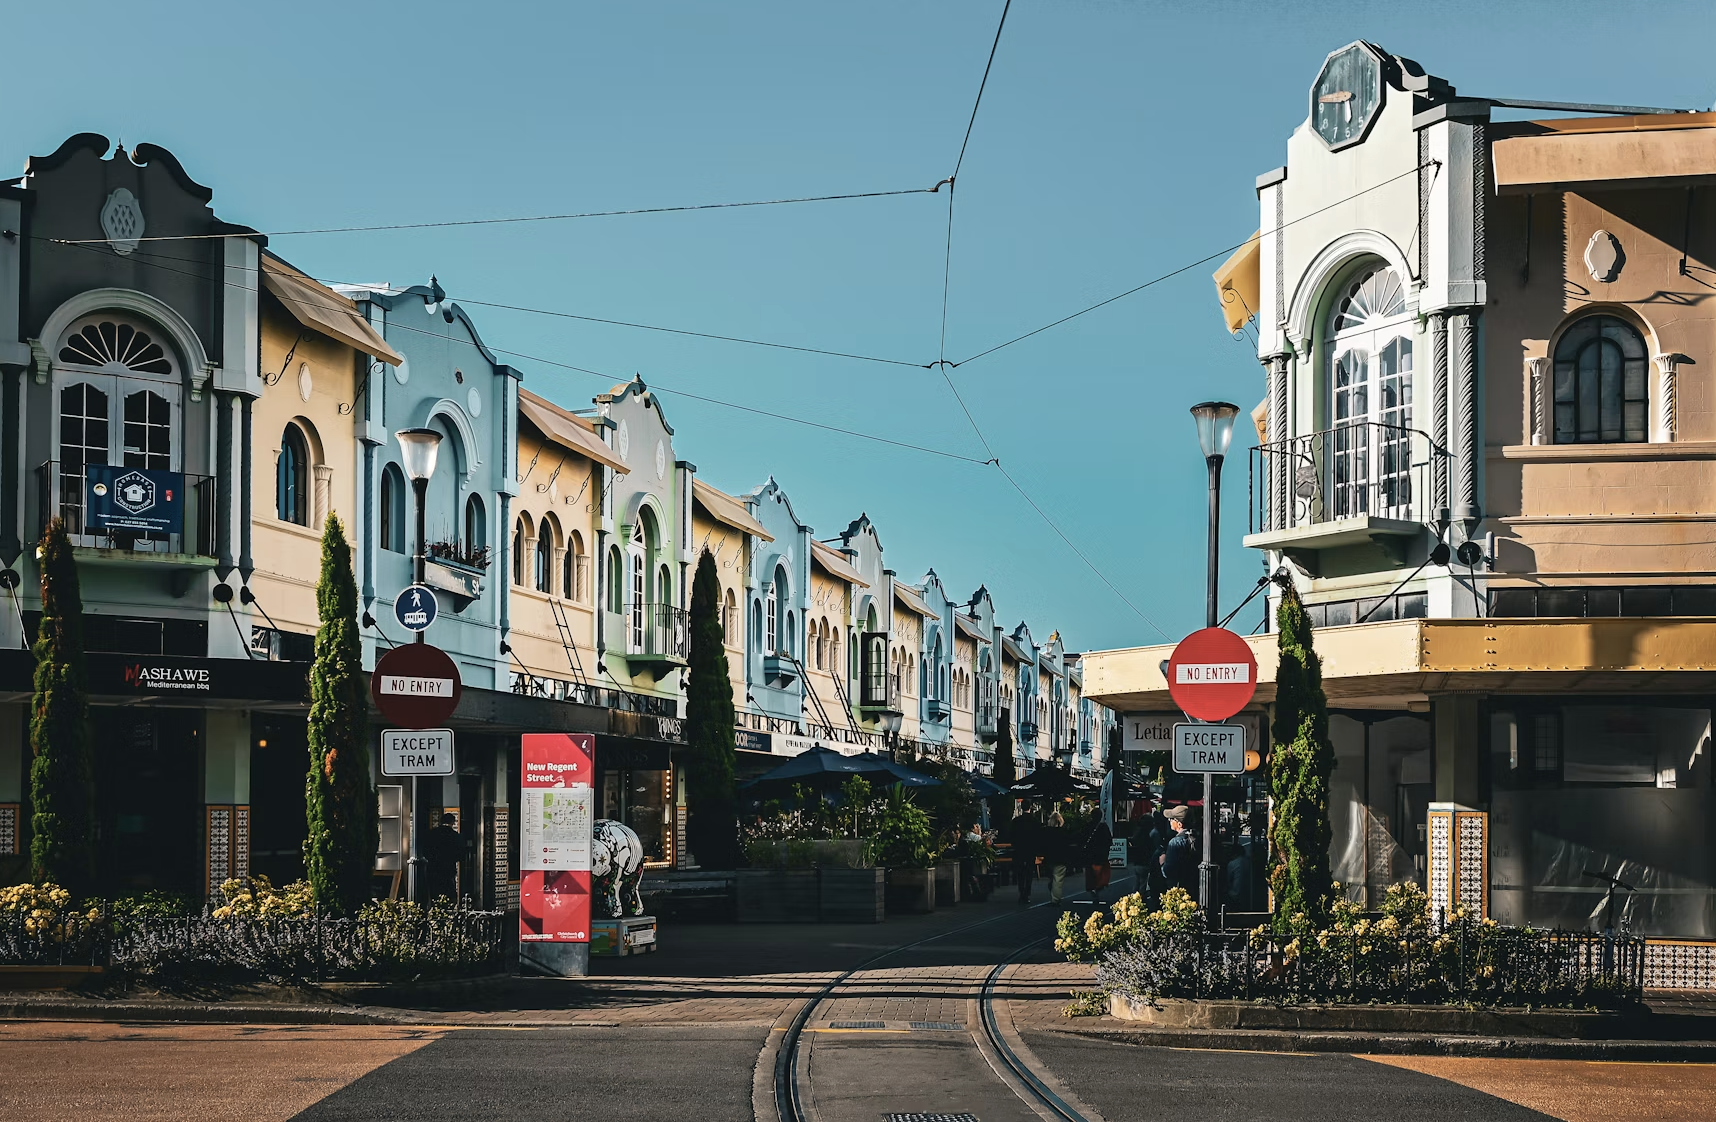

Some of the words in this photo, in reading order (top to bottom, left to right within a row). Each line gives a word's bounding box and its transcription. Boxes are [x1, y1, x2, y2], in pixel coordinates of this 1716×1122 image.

[1318, 103, 1325, 114] 9
[1322, 119, 1329, 130] 8
[1358, 115, 1364, 129] 5
[1332, 126, 1338, 139] 7
[1344, 127, 1351, 138] 6
[117, 497, 152, 510] CONSTRUCTION
[125, 663, 210, 687] MASHAWE
[1187, 667, 1200, 680] NO
[1206, 667, 1238, 680] ENTRY
[147, 681, 195, 690] Mediterranean
[196, 682, 210, 691] bbq
[391, 679, 405, 692] NO
[410, 680, 443, 694] ENTRY
[1134, 722, 1172, 740] Letia
[392, 737, 443, 751] EXCEPT
[1184, 732, 1235, 747] EXCEPT
[399, 754, 435, 768] TRAM
[1190, 750, 1227, 765] TRAM
[526, 762, 546, 771] New
[547, 762, 578, 773] Regent
[526, 773, 554, 782] Street
